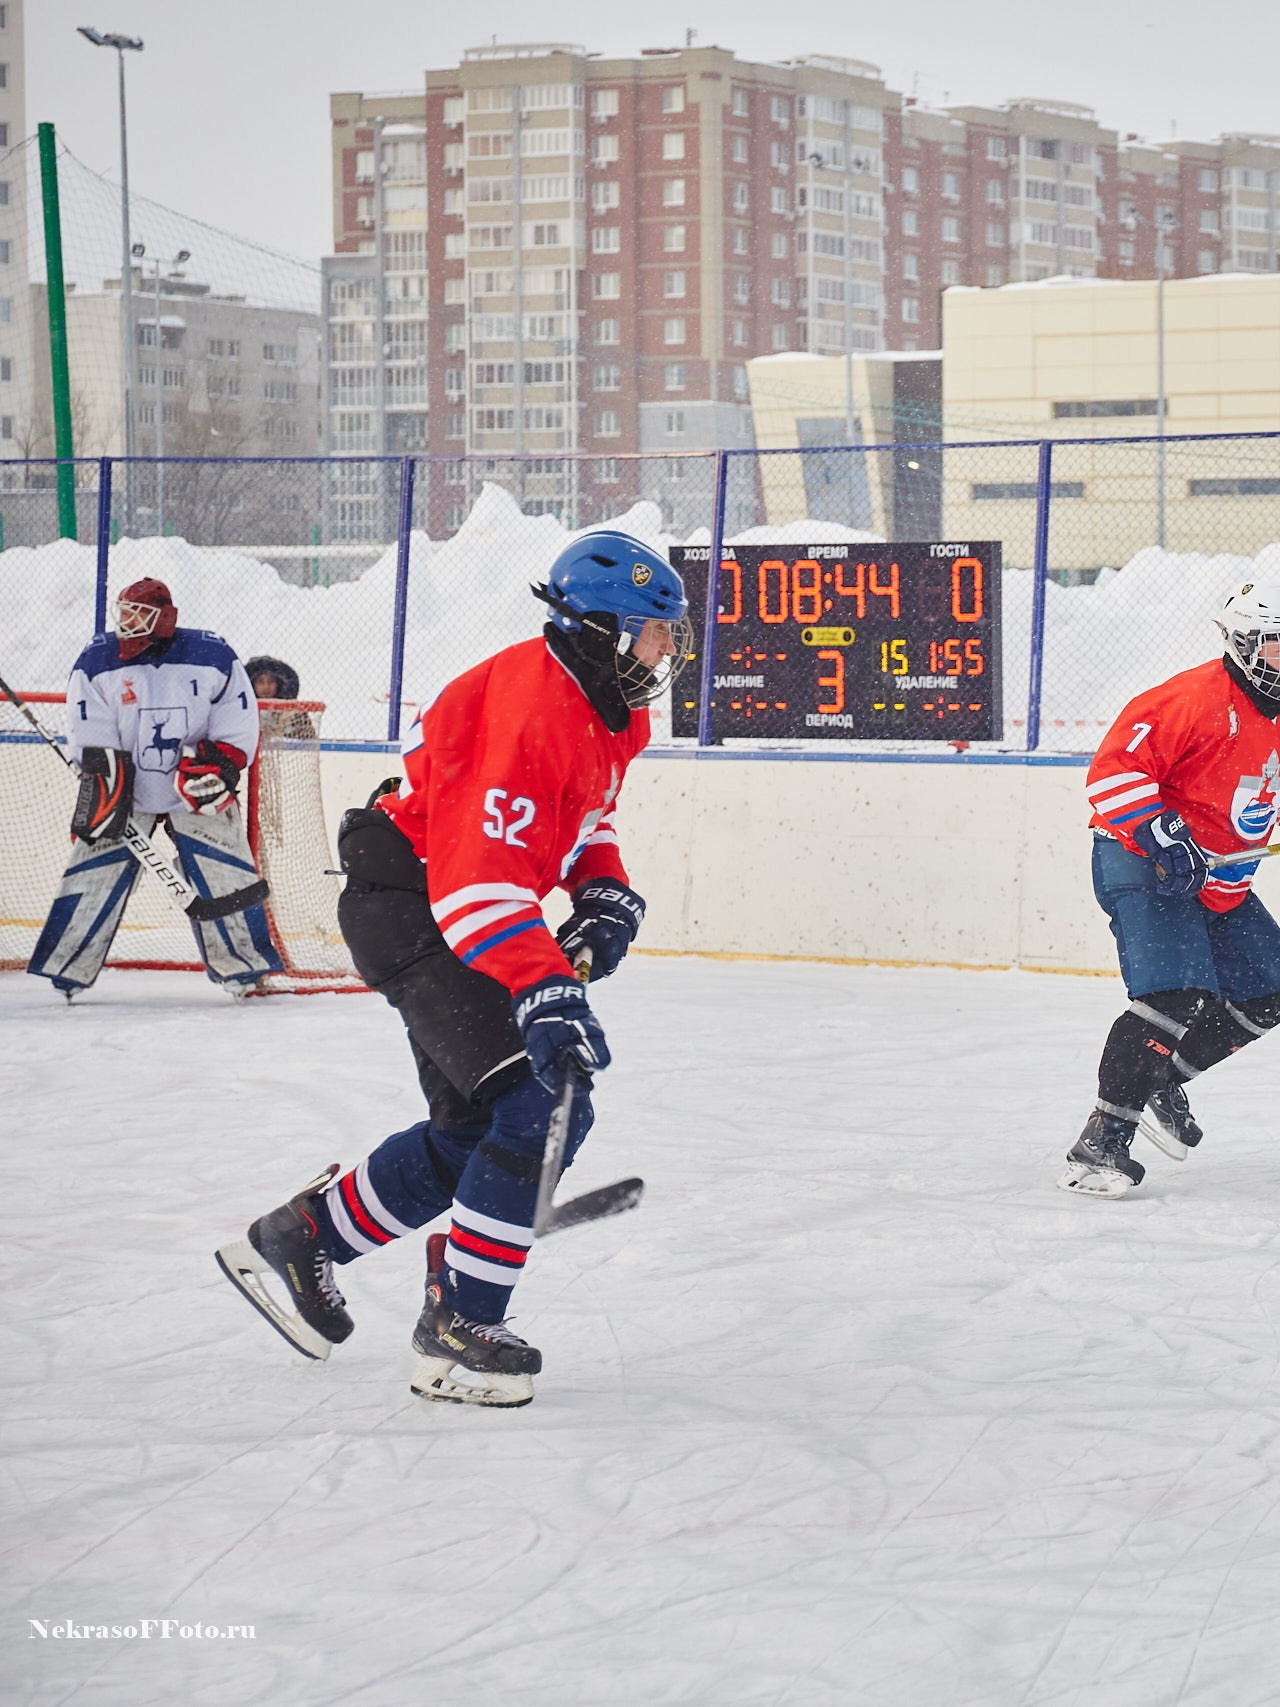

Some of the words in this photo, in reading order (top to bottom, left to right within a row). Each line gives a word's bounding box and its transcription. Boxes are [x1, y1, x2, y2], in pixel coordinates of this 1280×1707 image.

[683, 547, 736, 561] ХОЗЯВА
[807, 546, 849, 559] ВРЕМЯ
[929, 544, 970, 557] ГОСТИ
[758, 559, 900, 624] 08:44
[951, 557, 984, 623] 0
[881, 639, 909, 675] 15
[190, 679, 198, 696] 1
[713, 674, 765, 690] ДАЛЕНИЕ
[817, 649, 845, 714] 3
[895, 675, 958, 690] УДАЛЕНИЕ
[77, 700, 88, 720] 1
[237, 691, 248, 710] 1
[805, 713, 854, 729] ПЕРИОД
[1125, 722, 1153, 754] 7
[482, 787, 536, 849] 52
[581, 887, 644, 925] BAUE
